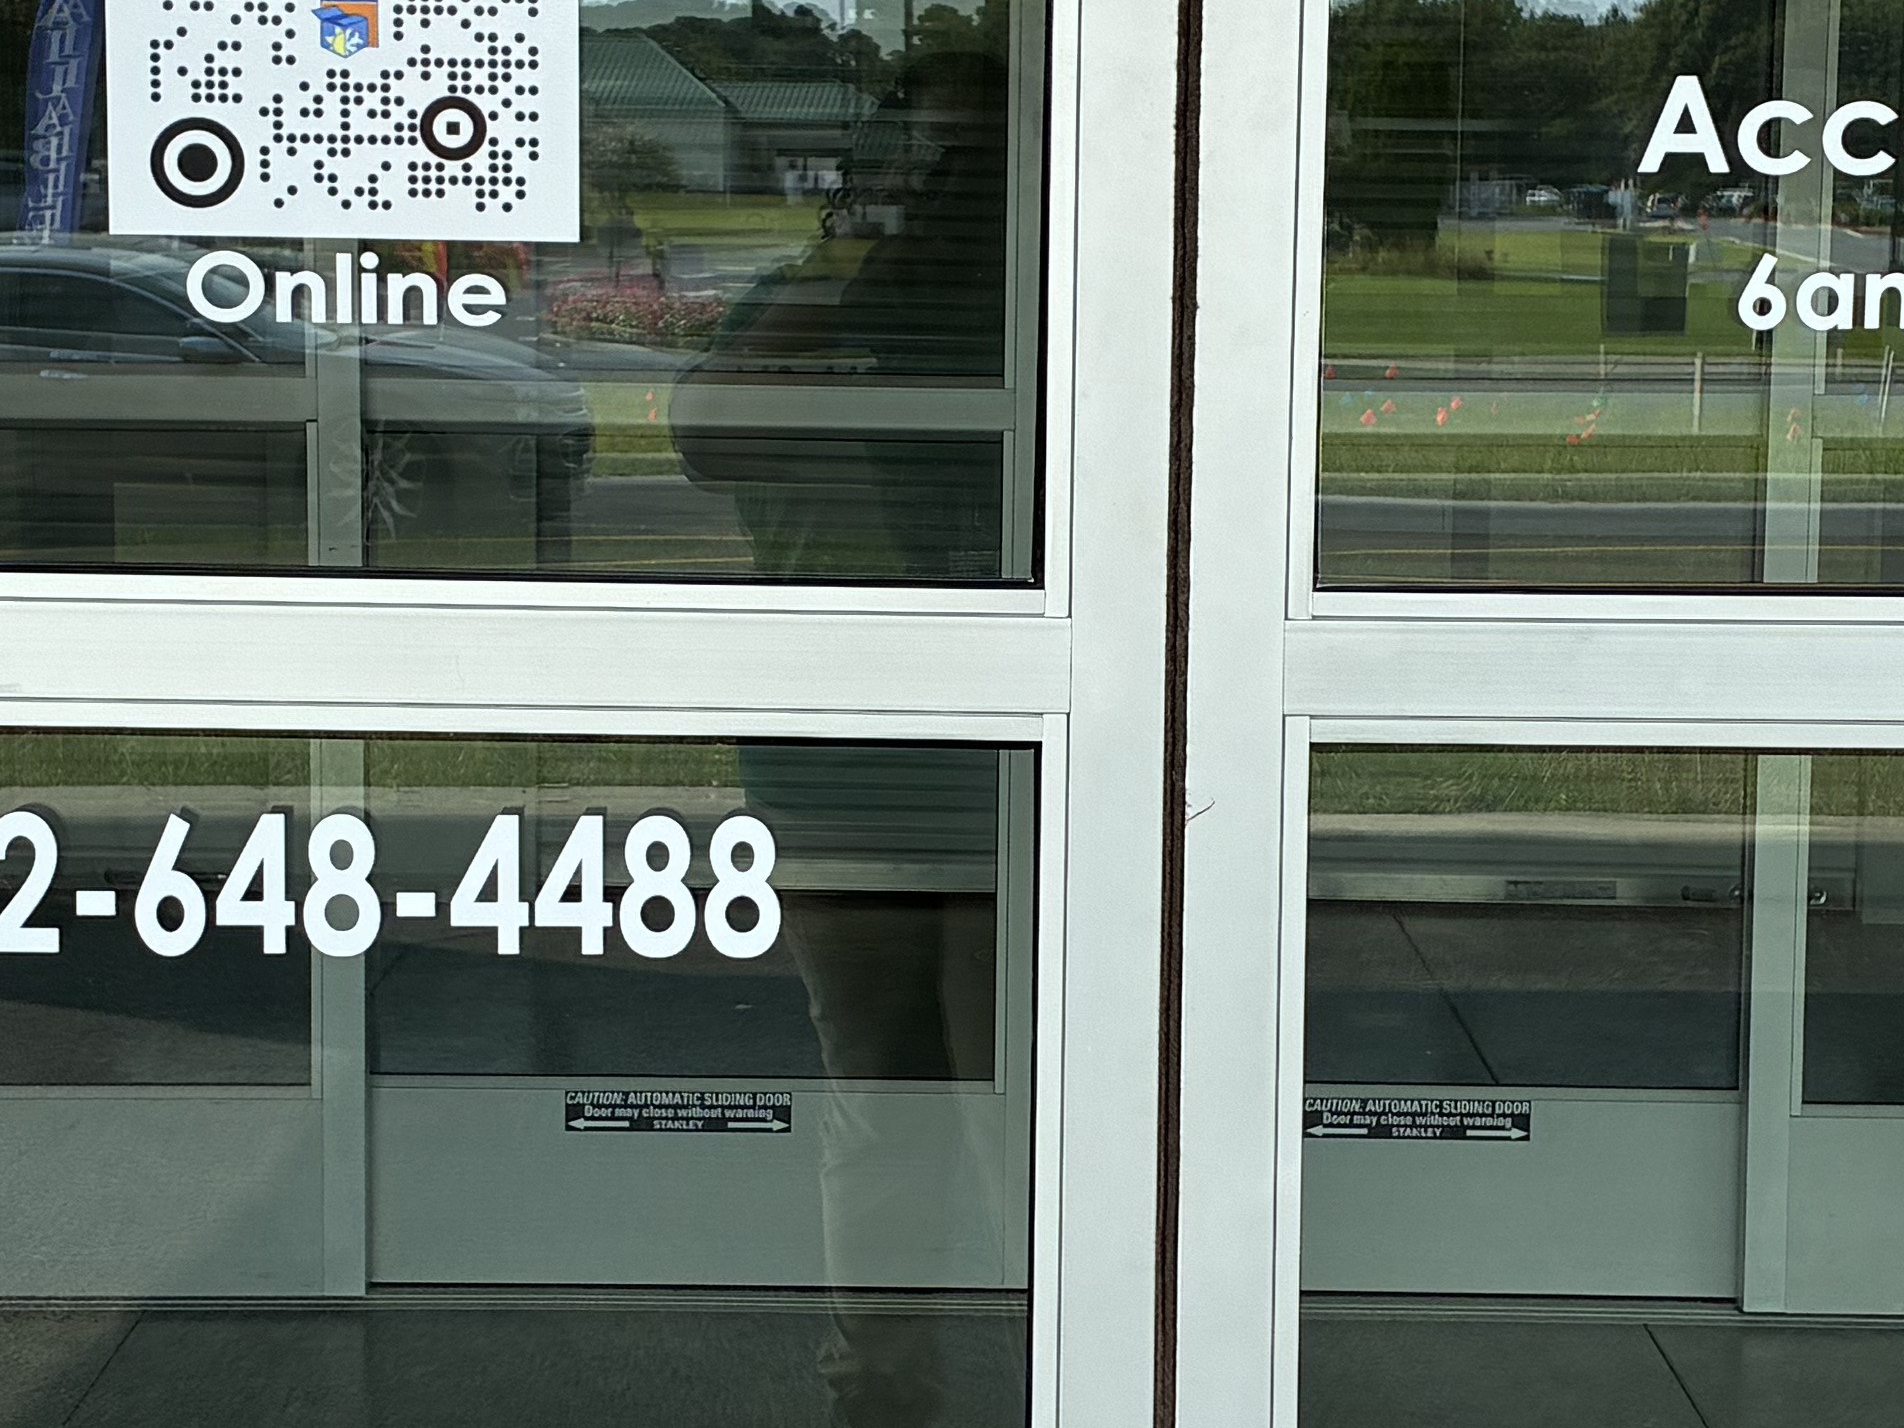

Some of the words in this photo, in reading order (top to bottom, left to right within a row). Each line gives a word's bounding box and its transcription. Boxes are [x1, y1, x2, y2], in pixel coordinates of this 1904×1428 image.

[186, 250, 507, 327] Online
[566, 1092, 625, 1105] CAUTION:
[628, 1092, 702, 1105] AUTOMATIC
[704, 1092, 754, 1106] SLIDING
[756, 1093, 791, 1107] DOOR
[584, 1105, 612, 1117] Door
[615, 1107, 638, 1119] may
[642, 1106, 675, 1117] close
[677, 1106, 722, 1118] without
[724, 1108, 774, 1121] warning
[1305, 1100, 1363, 1113] CAUTION:
[1366, 1100, 1440, 1114] AUTOMATIC
[1442, 1101, 1492, 1114] SLIDING
[1494, 1101, 1530, 1115] DOOR
[653, 1120, 704, 1130] STANLEY
[1322, 1114, 1351, 1125] Door
[1353, 1115, 1377, 1128] may
[1381, 1114, 1413, 1125] close
[1415, 1114, 1460, 1127] without
[1462, 1116, 1512, 1129] warning
[1391, 1128, 1443, 1138] STANLEY
